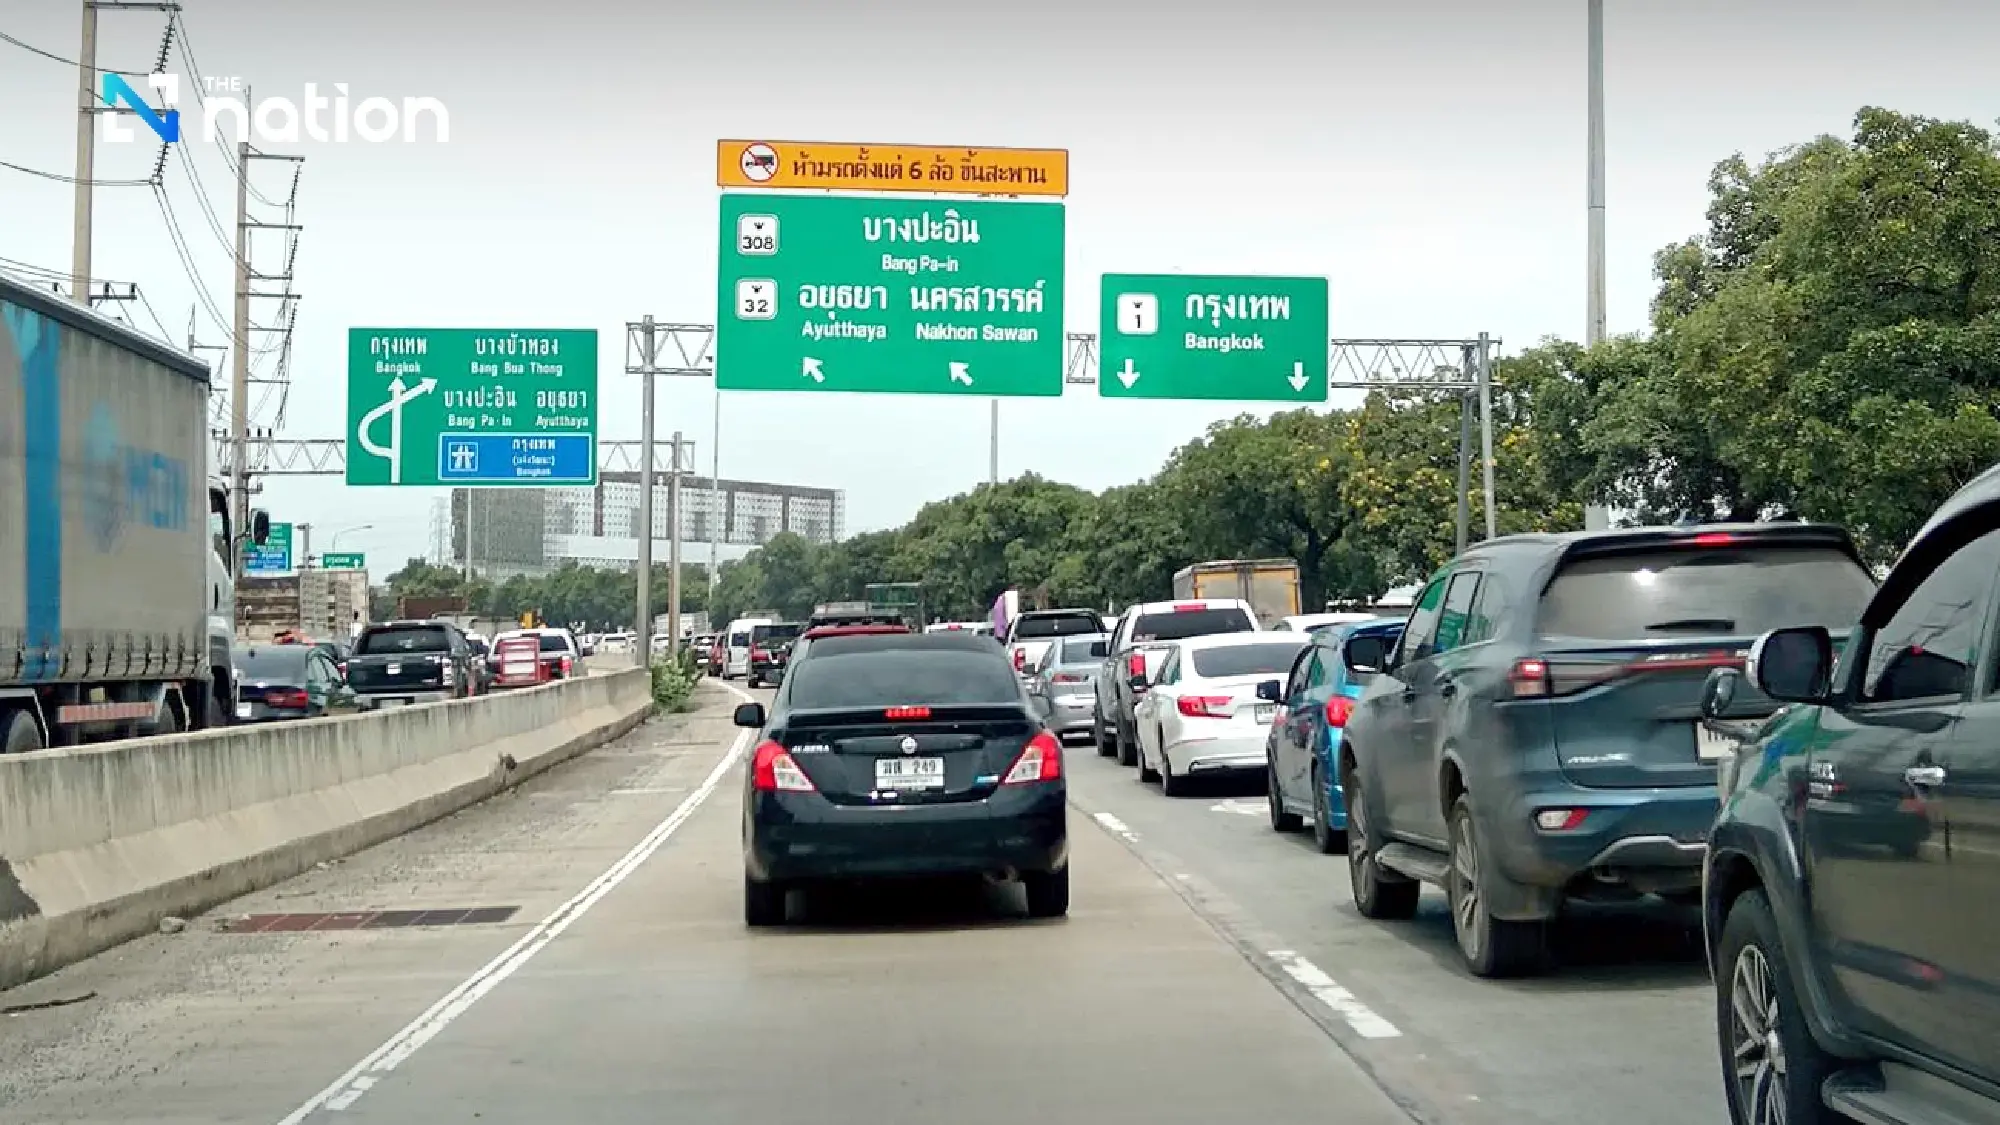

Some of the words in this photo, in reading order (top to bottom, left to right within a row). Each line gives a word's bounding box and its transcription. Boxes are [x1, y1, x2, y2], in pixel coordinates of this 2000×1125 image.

[793, 147, 904, 180] ห้ามรถตั้งแต่
[908, 162, 923, 179] 6
[929, 155, 953, 181] ล้อ
[959, 148, 1047, 183] ขึ้นสะพาน
[862, 208, 981, 243] บางปะอิน
[742, 236, 773, 250] 308
[882, 254, 917, 275] Bang
[744, 299, 768, 313] 32
[799, 284, 887, 321] อยุธยา
[910, 279, 1046, 313] นครสวรรค์
[1185, 294, 1290, 328] กรุงเทพ
[802, 321, 887, 342] Ayutthaya
[916, 322, 978, 341] Nakhon
[982, 324, 1038, 341] Sawan
[371, 336, 427, 359] กรุงเทพ
[475, 333, 559, 356] บางบัวทอง
[1185, 332, 1264, 353] Bangkok
[376, 361, 421, 375] Bangkok
[471, 362, 498, 377] Bang
[504, 362, 524, 374] Bua
[530, 362, 563, 377] Thong
[444, 385, 516, 408] บางปะอิน
[536, 390, 587, 413] อยุธยา
[448, 415, 475, 430] Bang
[535, 415, 588, 430] Ayutthaya
